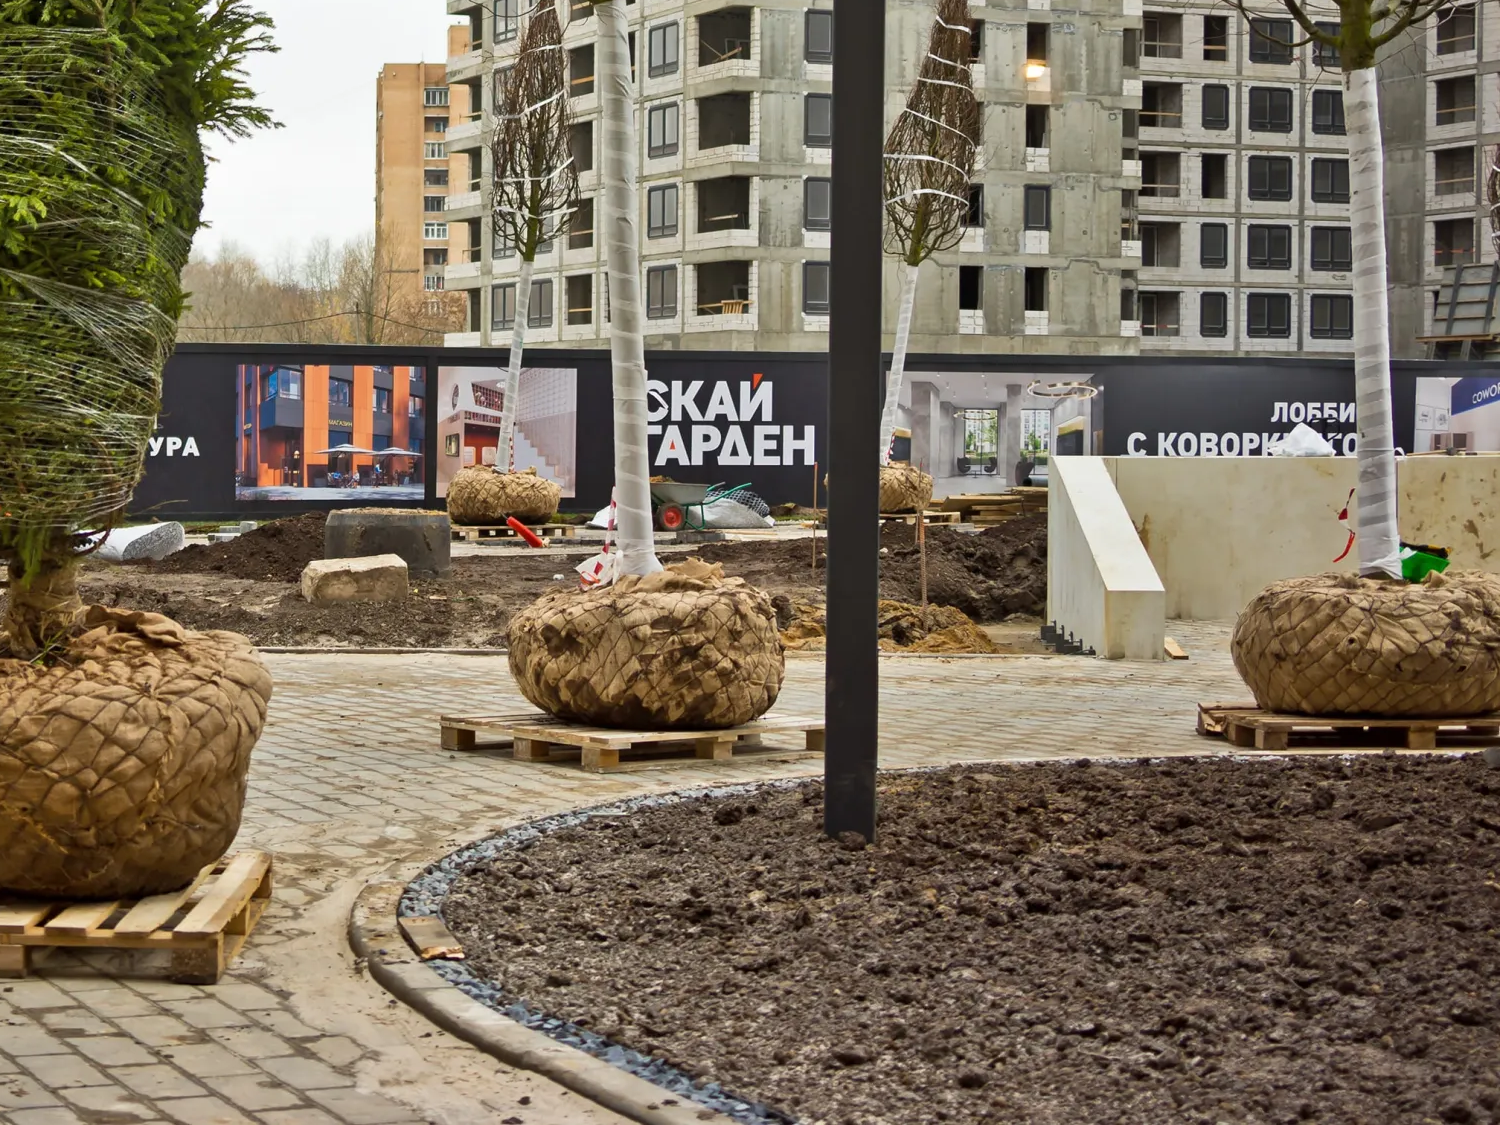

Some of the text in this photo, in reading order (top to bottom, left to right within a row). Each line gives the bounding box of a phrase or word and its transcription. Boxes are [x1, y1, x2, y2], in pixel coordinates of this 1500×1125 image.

[647, 373, 773, 422] СКАЙ
[1270, 401, 1356, 423] ЛОББИ
[148, 436, 200, 457] УРА
[1127, 431, 1148, 456] С
